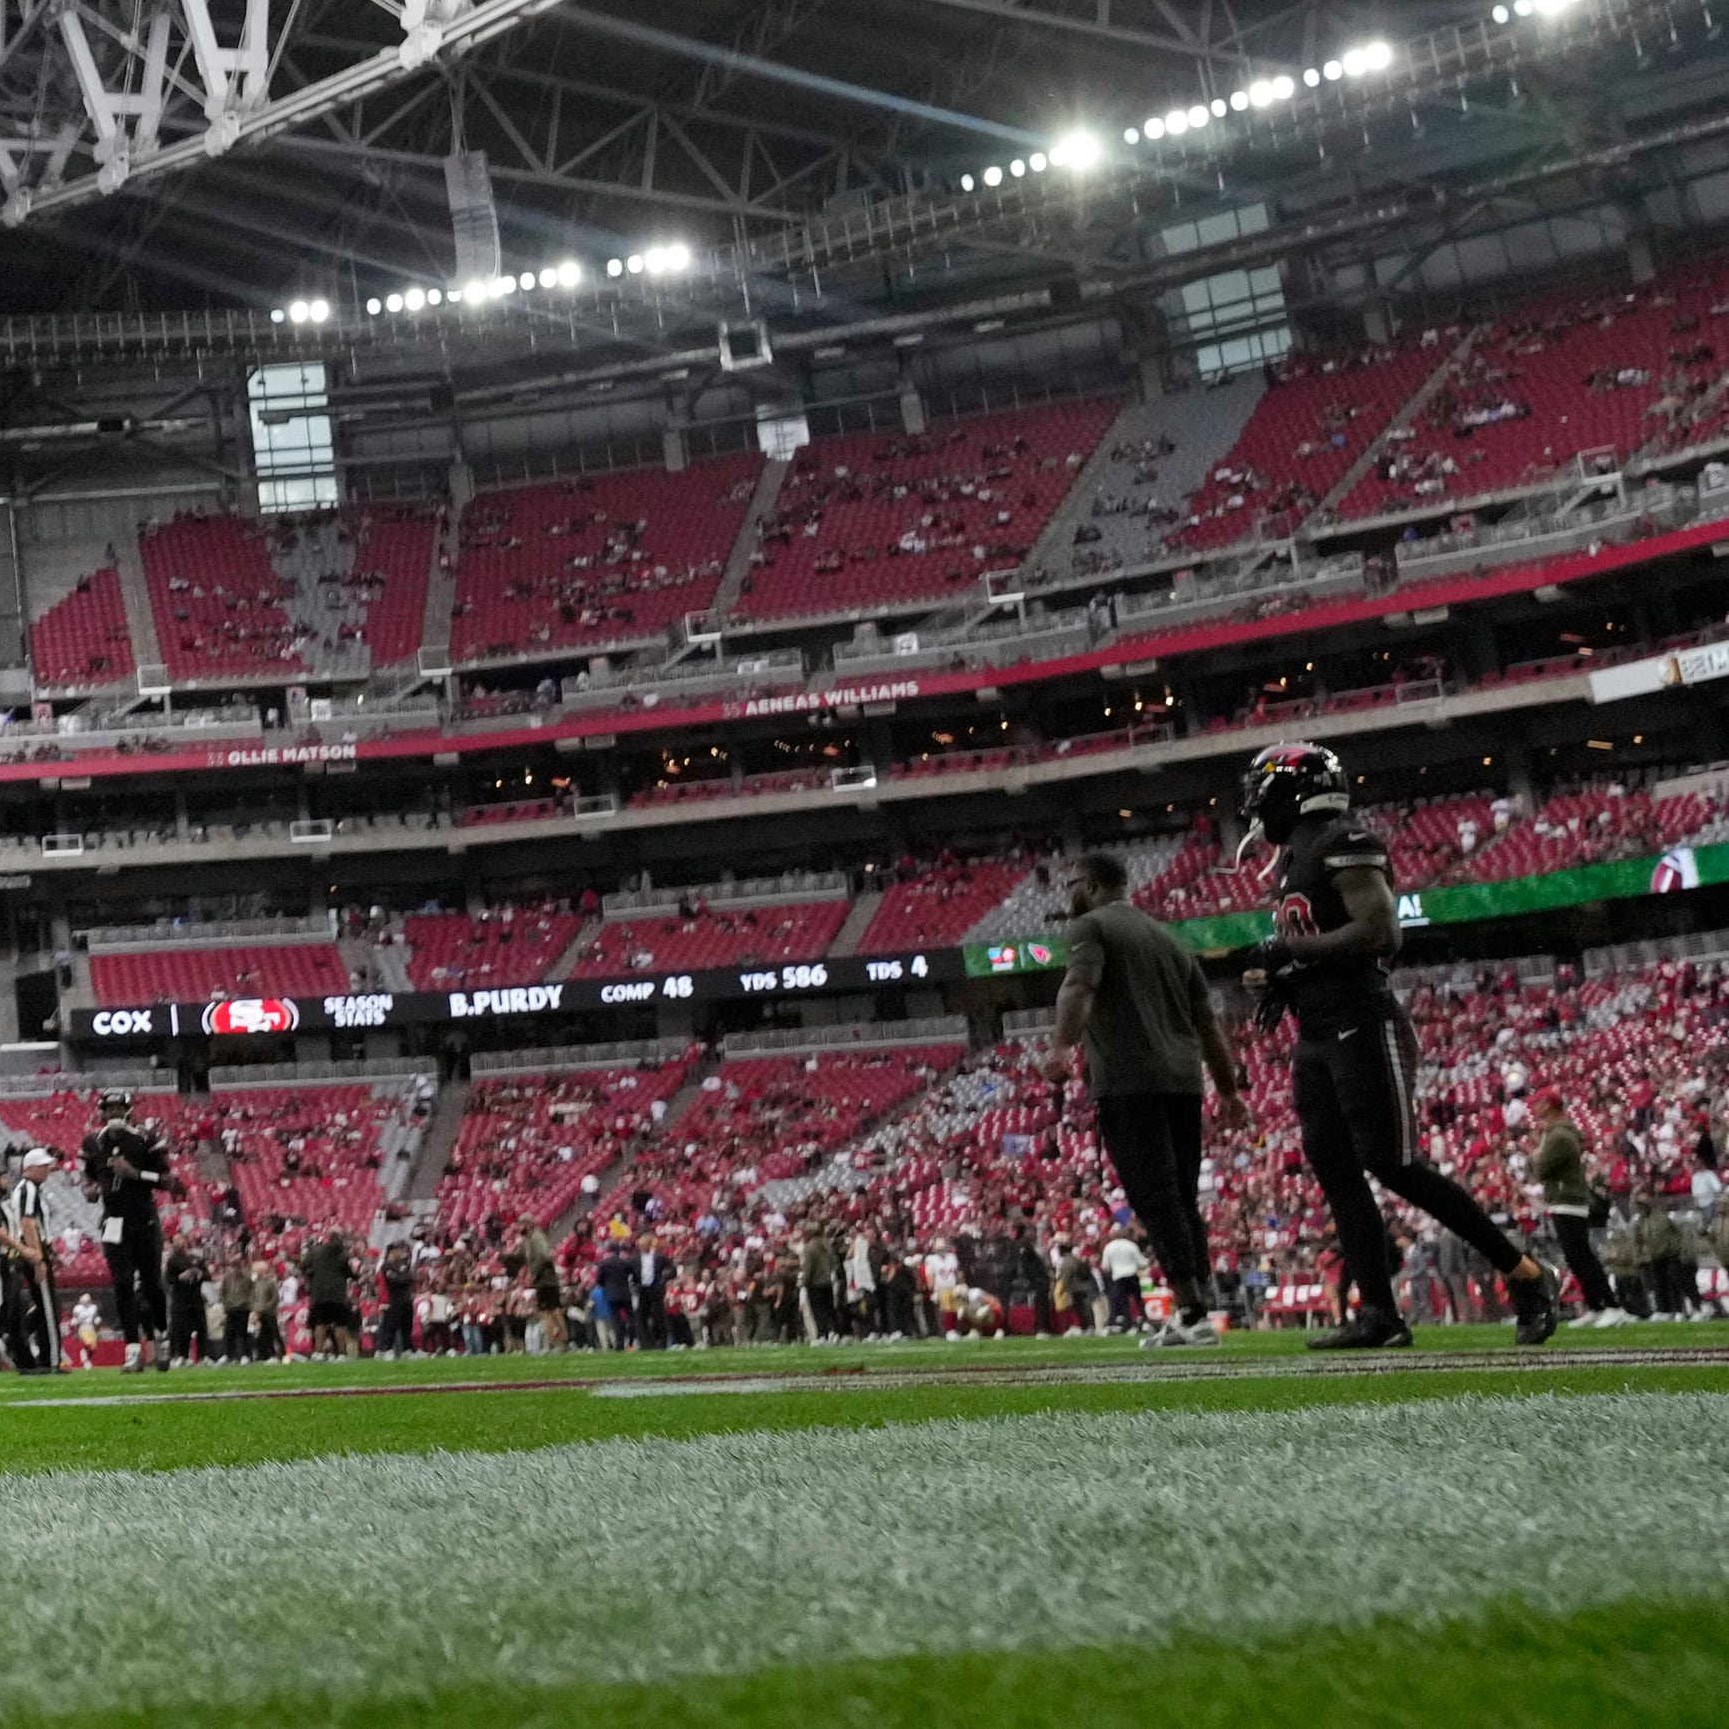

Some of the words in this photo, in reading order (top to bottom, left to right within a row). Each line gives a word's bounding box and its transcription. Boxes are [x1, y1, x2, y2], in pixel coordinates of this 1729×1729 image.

[745, 692, 821, 716] AENEAS
[825, 680, 919, 706] WILLIAMS
[228, 750, 279, 766] OLLIE
[282, 744, 356, 762] MATSON
[449, 984, 563, 1017] B.PURDY
[601, 982, 655, 1003] COMP
[663, 975, 693, 999] 48
[741, 972, 777, 992] YDS
[782, 964, 828, 989] 586
[866, 961, 903, 982] TDS
[910, 955, 929, 978] 4
[324, 994, 392, 1014] SEASON
[93, 1010, 152, 1036] COX
[334, 1009, 386, 1028] STATS
